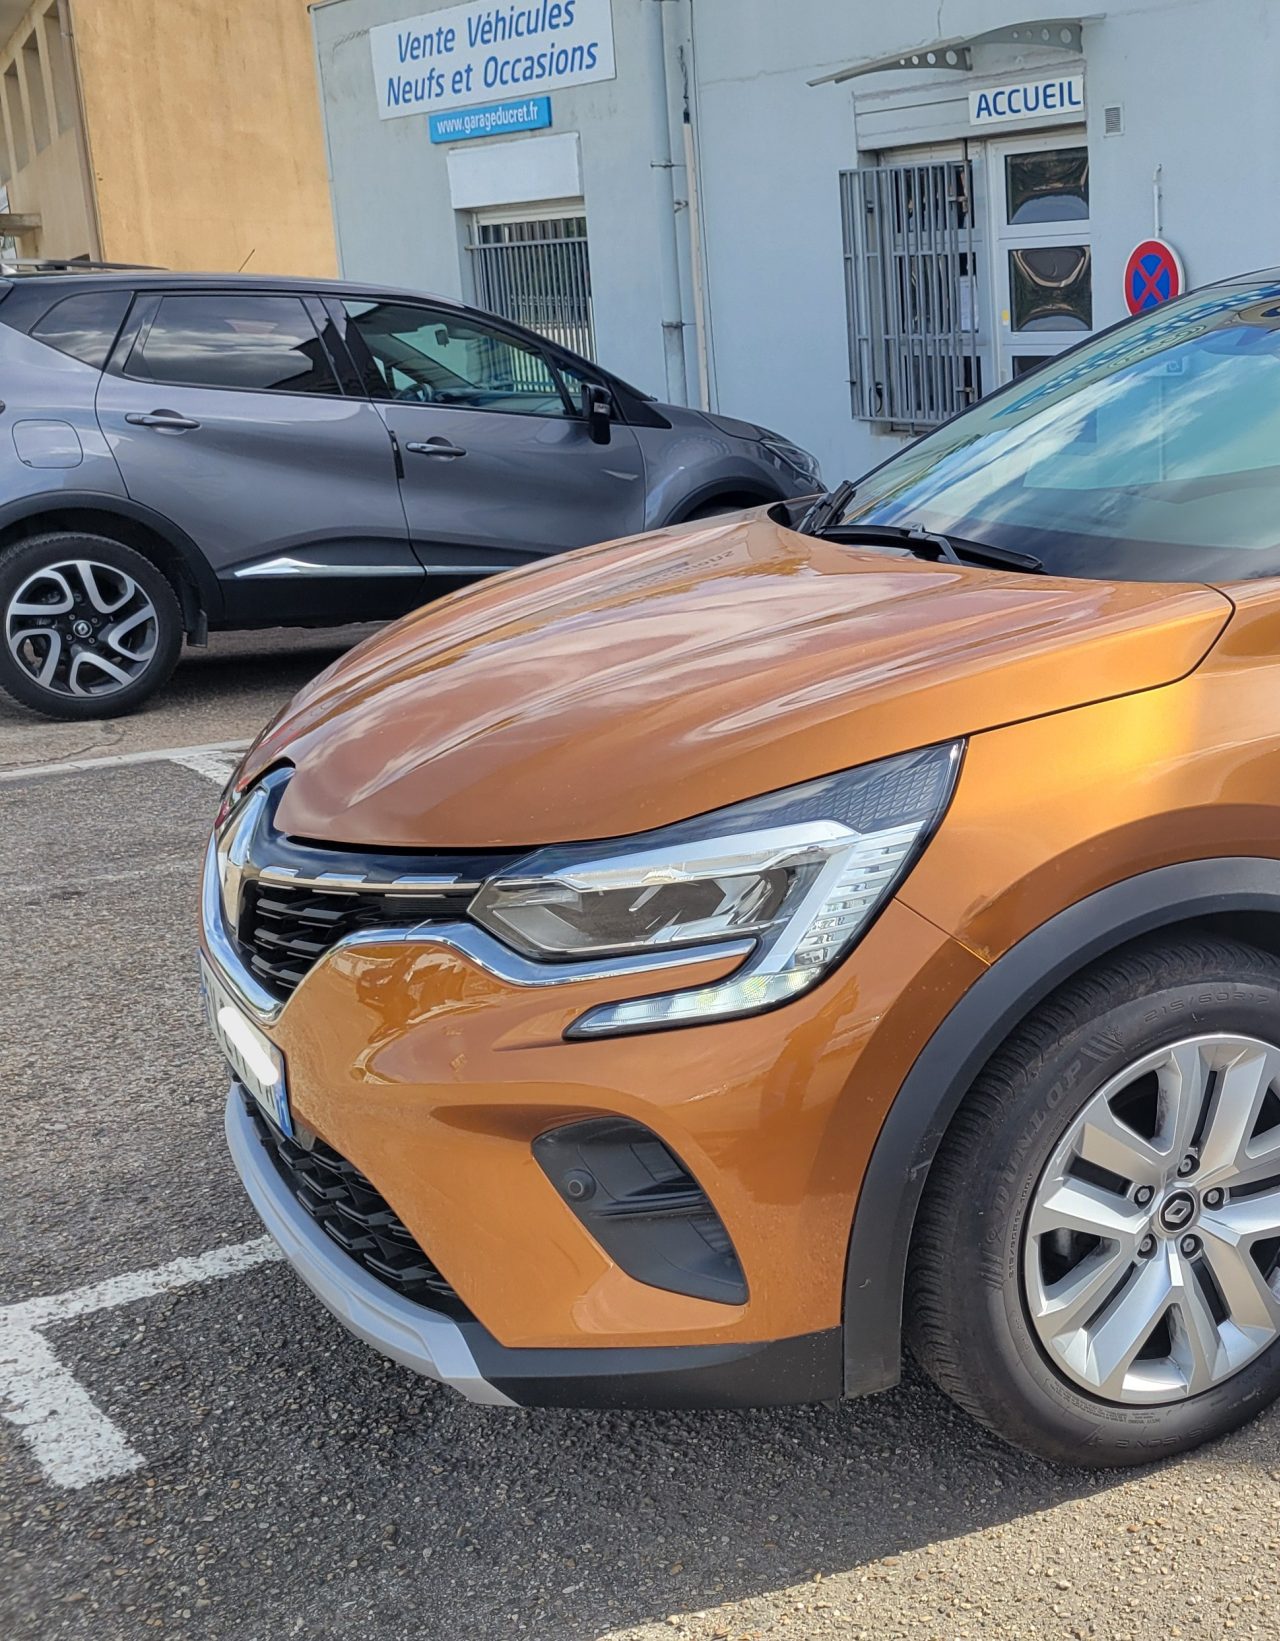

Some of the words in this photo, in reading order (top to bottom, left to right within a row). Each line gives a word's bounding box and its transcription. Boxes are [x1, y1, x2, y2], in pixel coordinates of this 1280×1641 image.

[397, 26, 456, 64] Vente
[467, 0, 576, 48] Véhicules
[387, 67, 445, 107] Neufs
[451, 63, 473, 94] et
[483, 42, 599, 88] Occasions
[976, 80, 1082, 119] ACCUEIL
[436, 101, 539, 136] www.garageducret.fr
[991, 1060, 1085, 1215] DUNLOP
